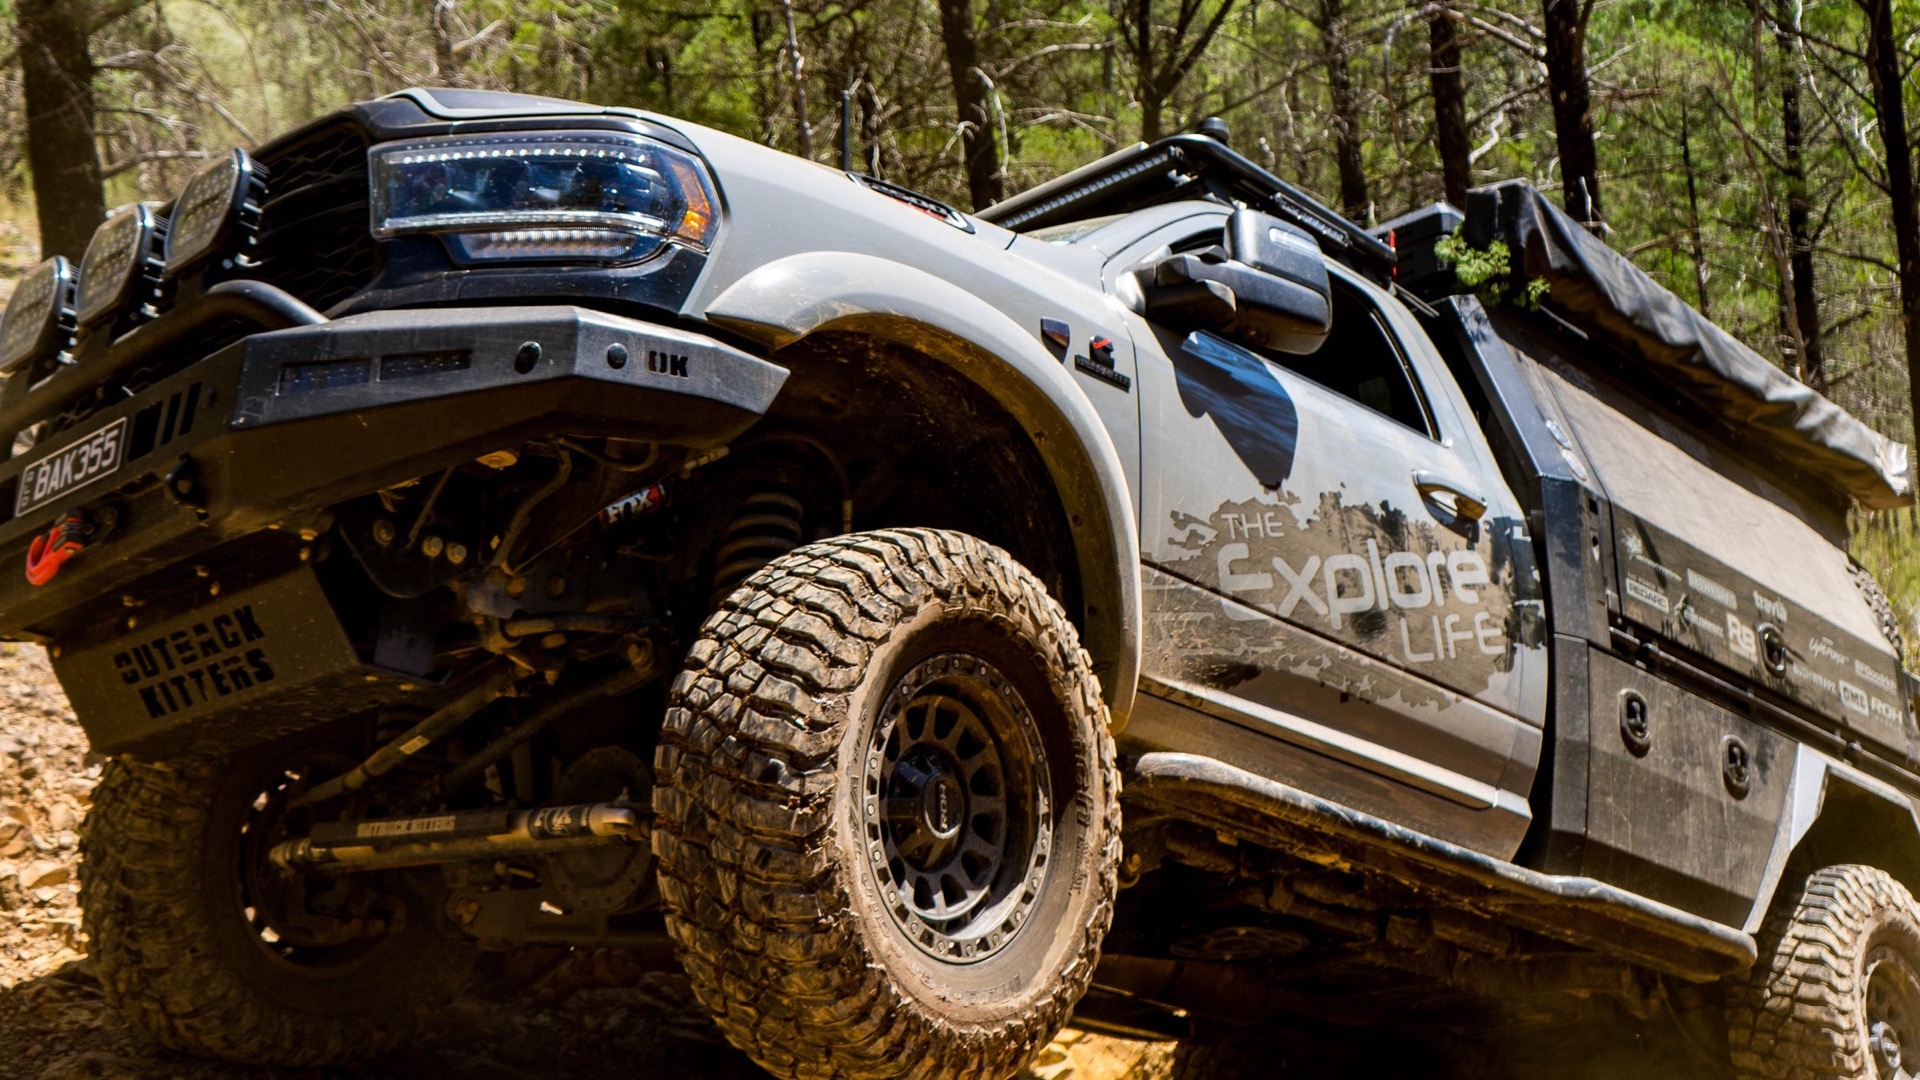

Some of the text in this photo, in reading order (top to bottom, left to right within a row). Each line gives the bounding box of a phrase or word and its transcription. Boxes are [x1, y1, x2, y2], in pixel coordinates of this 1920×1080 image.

[32, 428, 120, 501] BAK355
[1220, 511, 1285, 540] THE
[1217, 537, 1490, 631] Explore
[113, 604, 266, 686] OUTBACK
[1401, 610, 1506, 663] LIFE
[138, 649, 276, 719] KITTERS
[1870, 696, 1904, 724] ROH
